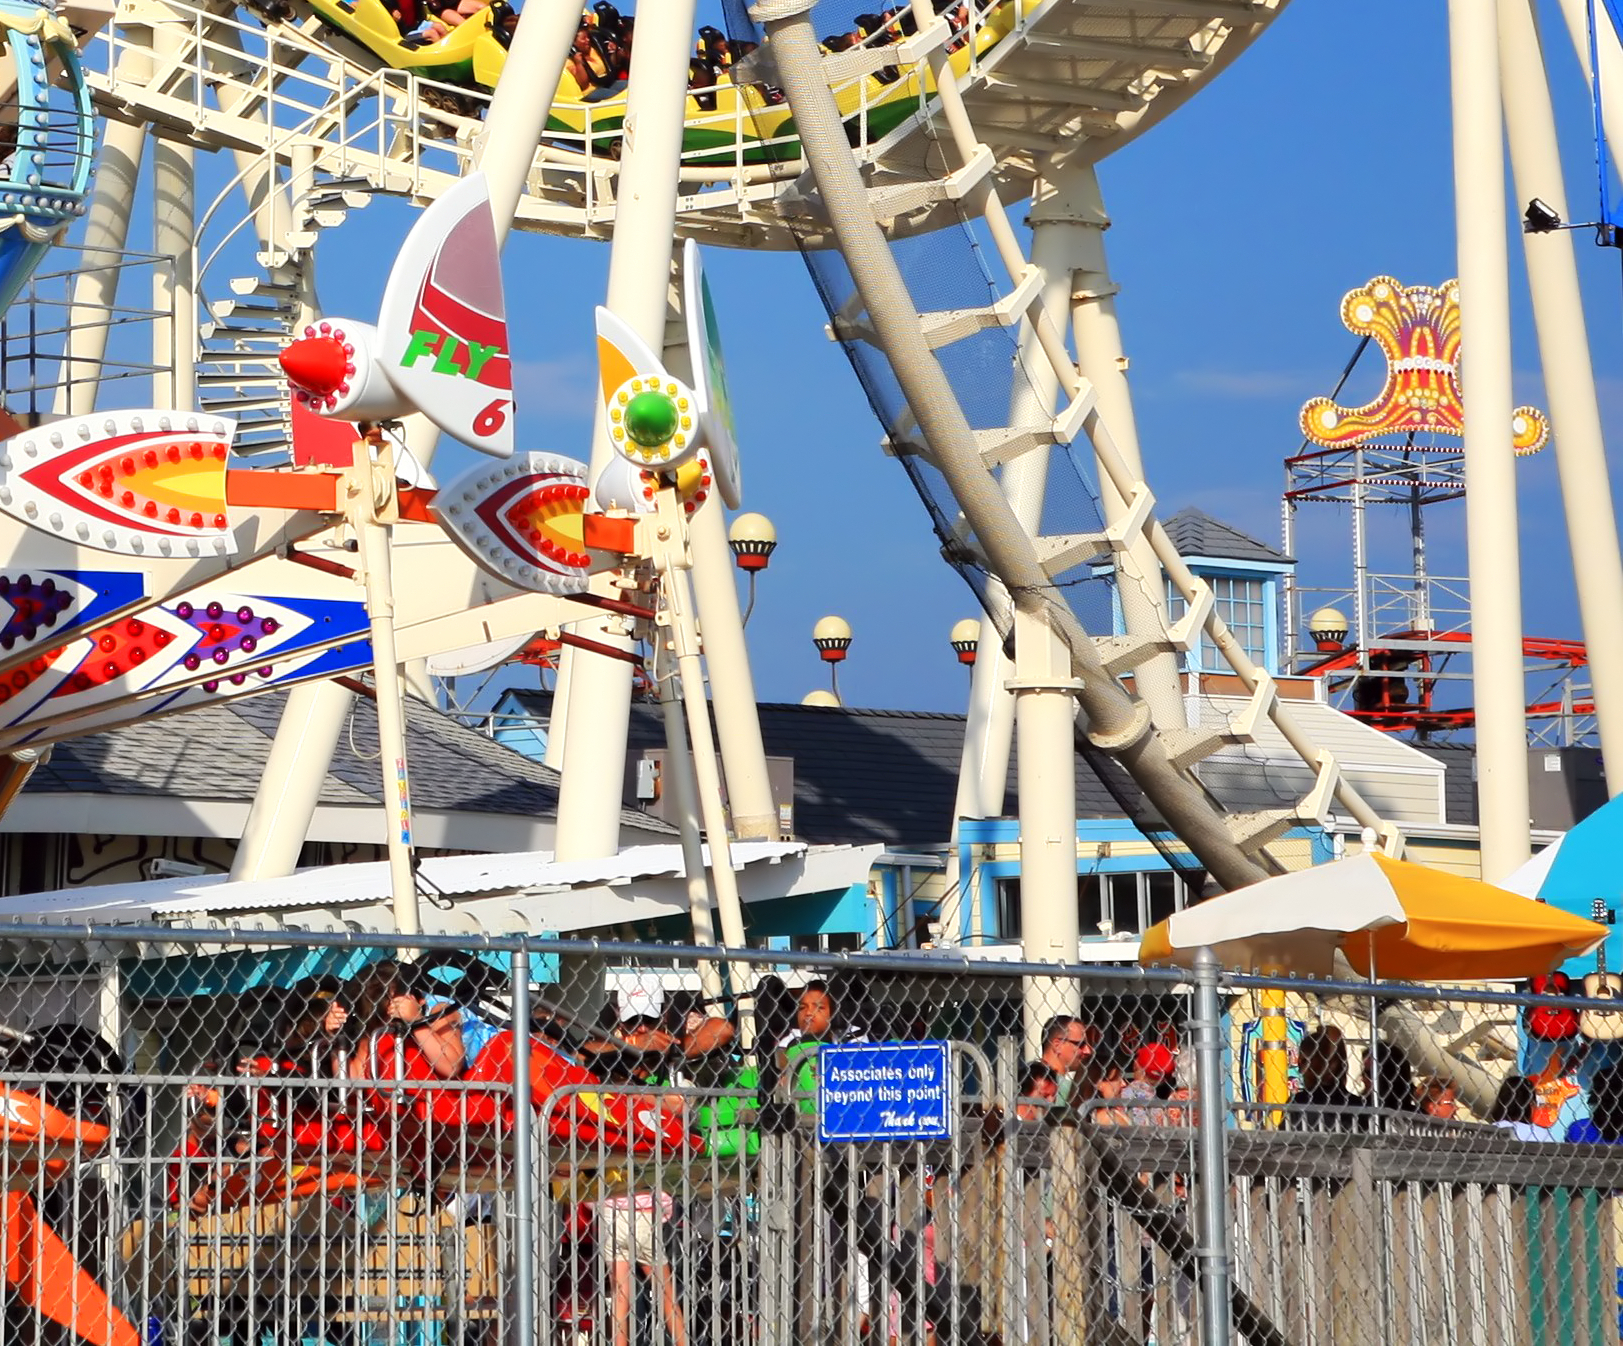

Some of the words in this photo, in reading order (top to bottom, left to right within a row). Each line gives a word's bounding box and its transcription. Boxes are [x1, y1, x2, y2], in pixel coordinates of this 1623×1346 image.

[399, 329, 501, 380] FLY
[472, 398, 511, 437] 6
[831, 1066, 902, 1082] Associates
[908, 1064, 935, 1081] only
[826, 1087, 873, 1105] beyond
[879, 1086, 902, 1101] this
[907, 1085, 941, 1103] point
